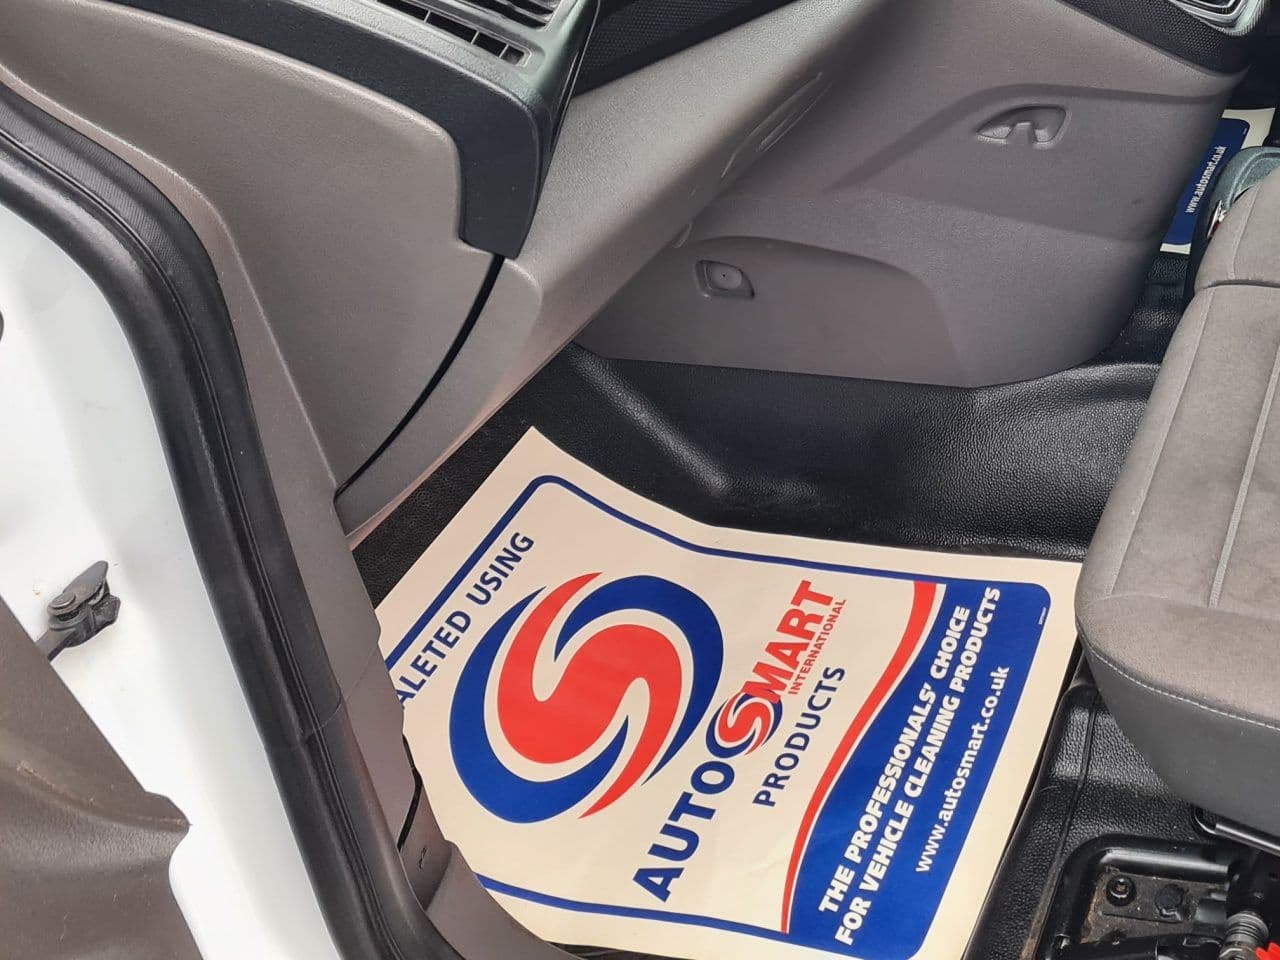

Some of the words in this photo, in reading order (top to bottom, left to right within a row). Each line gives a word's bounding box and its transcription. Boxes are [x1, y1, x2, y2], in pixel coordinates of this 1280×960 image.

[1185, 144, 1227, 214] www.autosmart.co.uk
[465, 532, 535, 606] USING
[788, 598, 847, 695] INTERNATIONAL
[752, 666, 846, 808] PRODUCTS
[818, 864, 855, 913] THE
[844, 681, 937, 865] PROFESSIONALS'
[929, 605, 971, 680] CHOICE
[834, 895, 872, 946] FOR
[859, 799, 915, 892] VEHICLE
[903, 694, 961, 799] CLEANING
[948, 586, 1001, 694] PRODUCTS
[915, 665, 1010, 873] www.autosmart.co.uk
